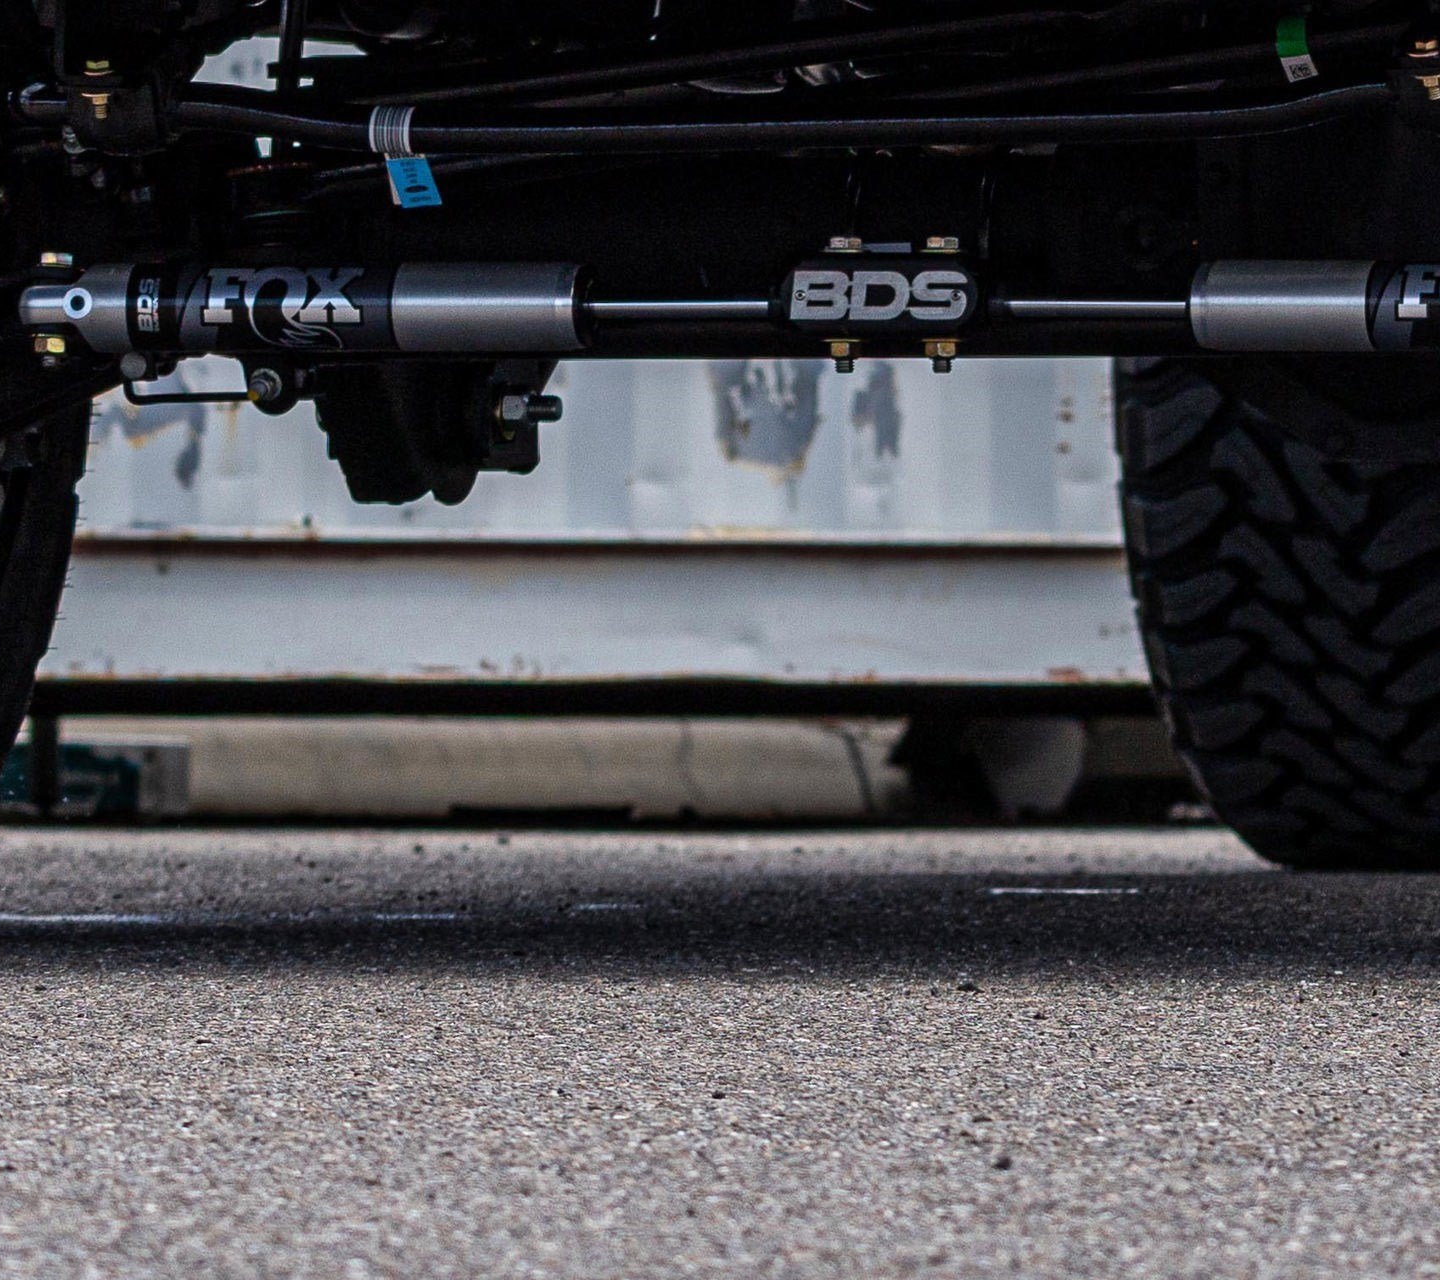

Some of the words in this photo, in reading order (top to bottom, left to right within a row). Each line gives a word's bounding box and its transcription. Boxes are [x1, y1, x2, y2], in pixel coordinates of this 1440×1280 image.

[137, 278, 154, 332] BDS
[203, 266, 365, 348] FOX
[790, 270, 968, 321] BDS
